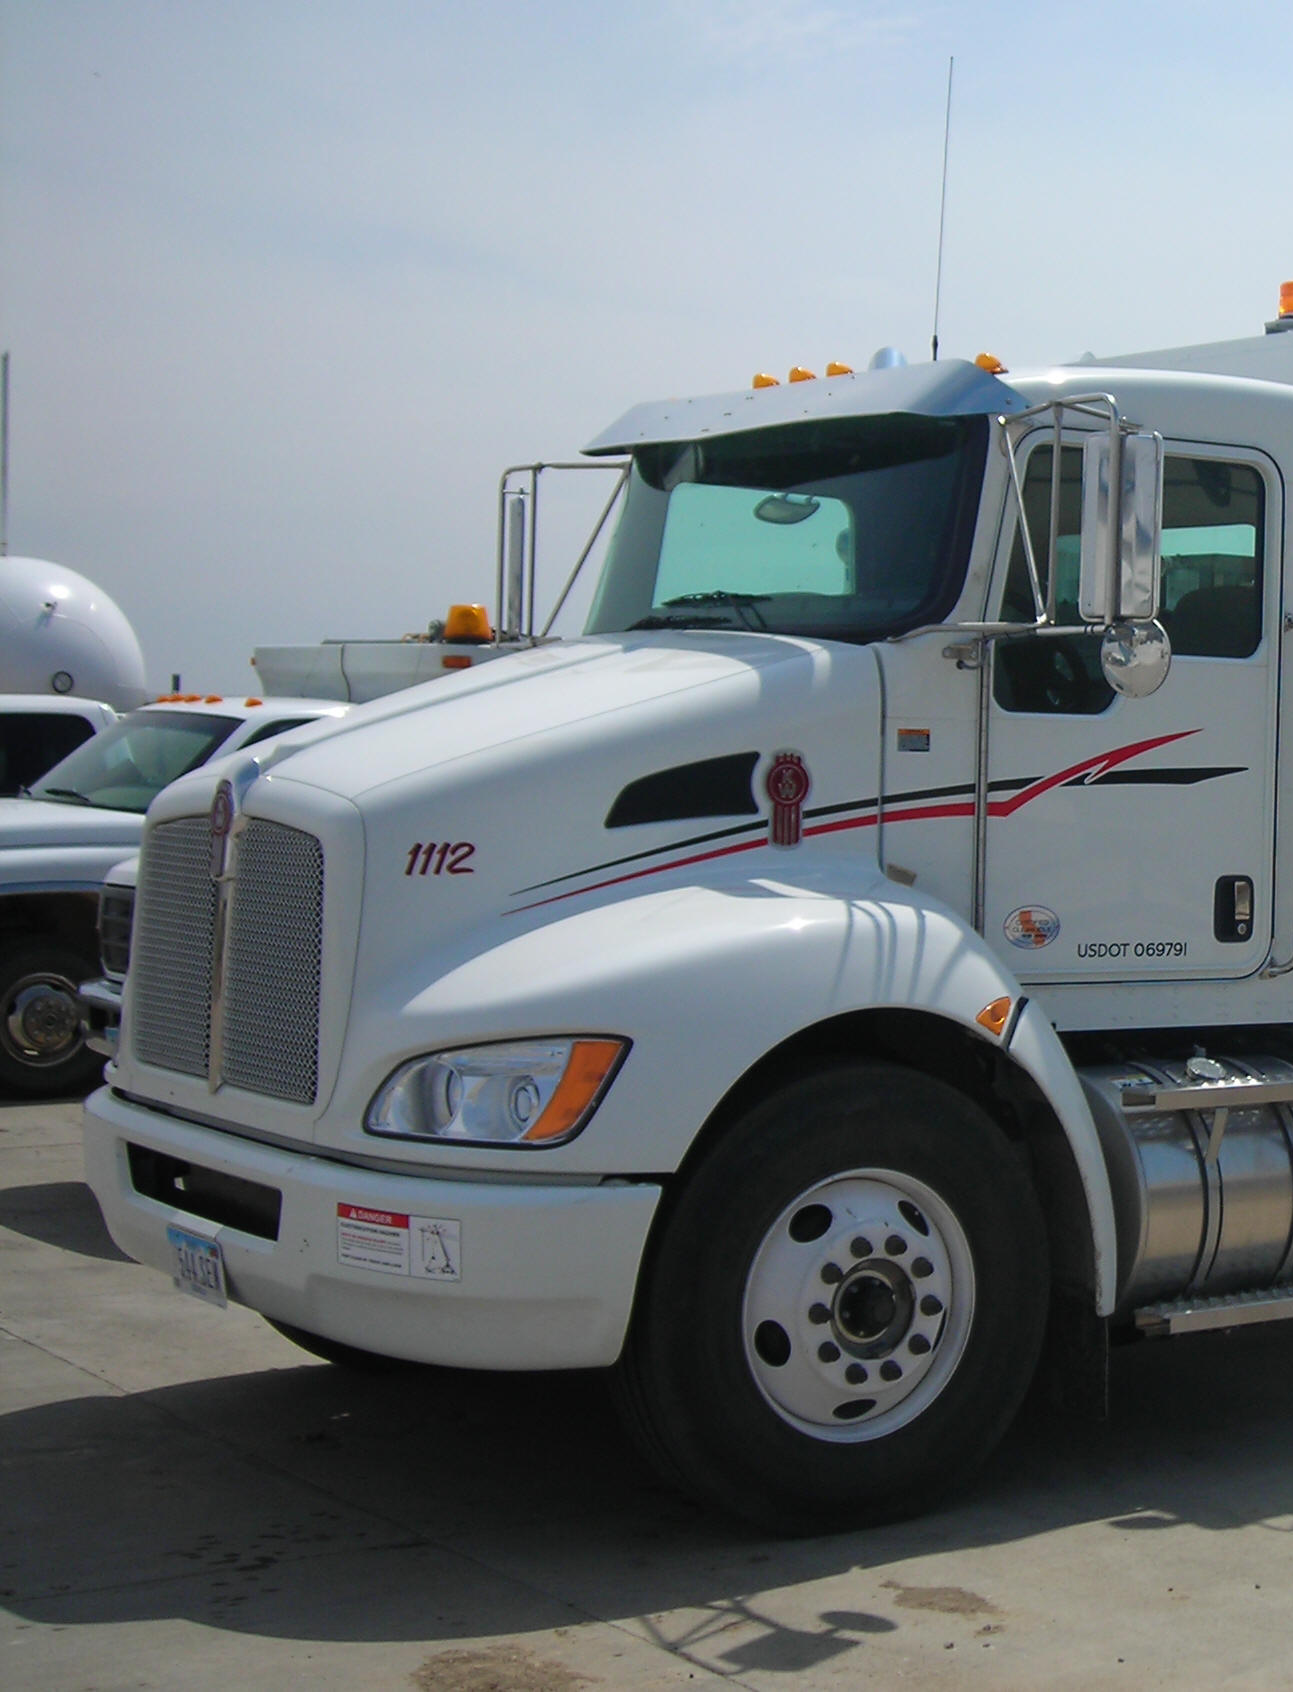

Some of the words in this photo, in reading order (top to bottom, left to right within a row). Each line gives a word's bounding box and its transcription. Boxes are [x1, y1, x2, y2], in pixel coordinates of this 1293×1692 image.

[405, 842, 476, 876] 1112
[1077, 943, 1130, 958] USDOT
[1133, 942, 1187, 957] 069791
[357, 1209, 392, 1224] DANGER
